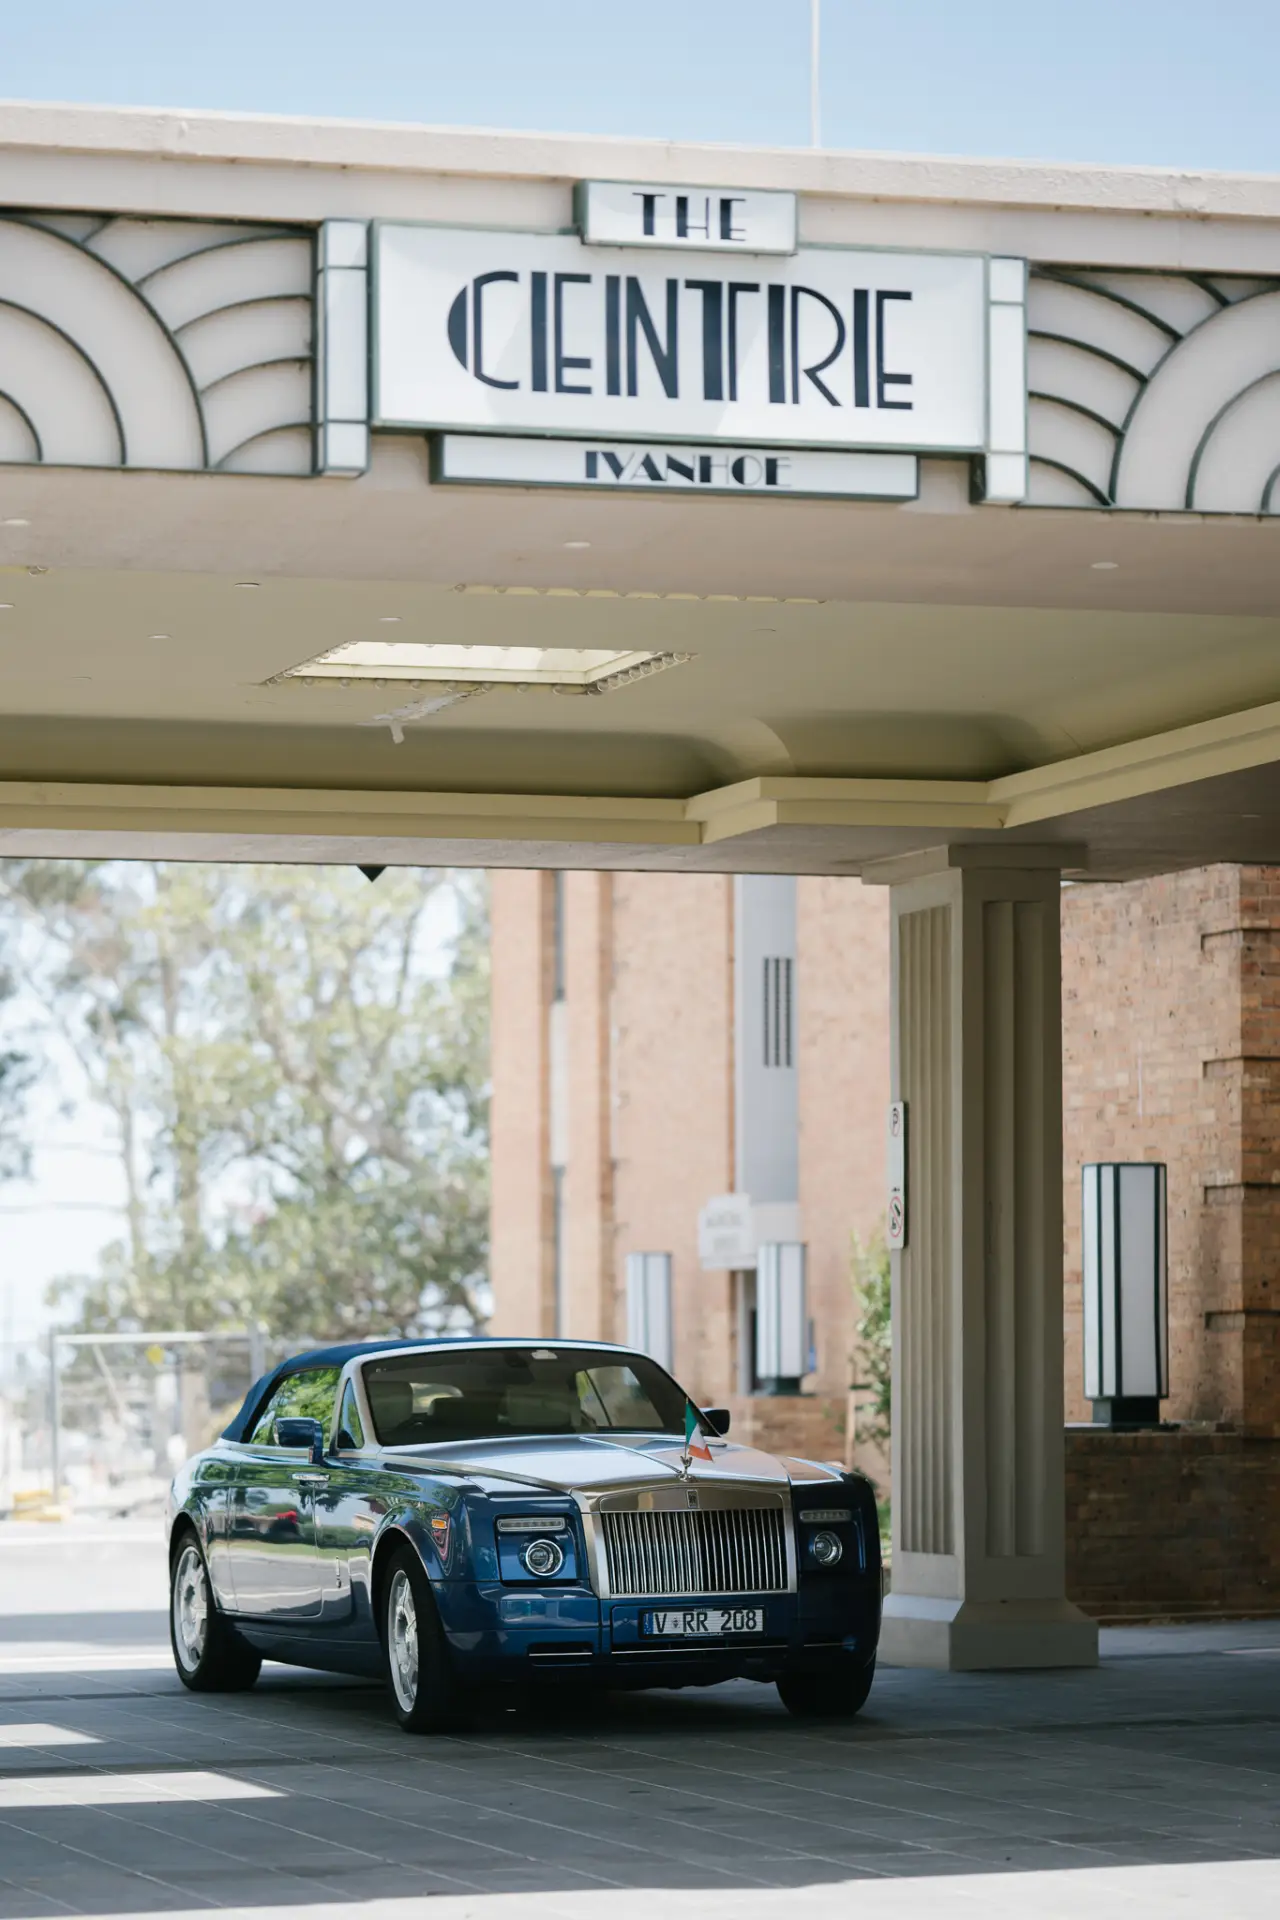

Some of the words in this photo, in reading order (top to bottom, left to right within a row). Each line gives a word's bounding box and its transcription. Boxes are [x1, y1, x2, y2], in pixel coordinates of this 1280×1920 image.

[632, 192, 746, 241] THE
[446, 270, 913, 410] CENTRE
[585, 450, 792, 488] IVANHOE
[683, 1612, 709, 1632] RR
[720, 1609, 757, 1631] 208
